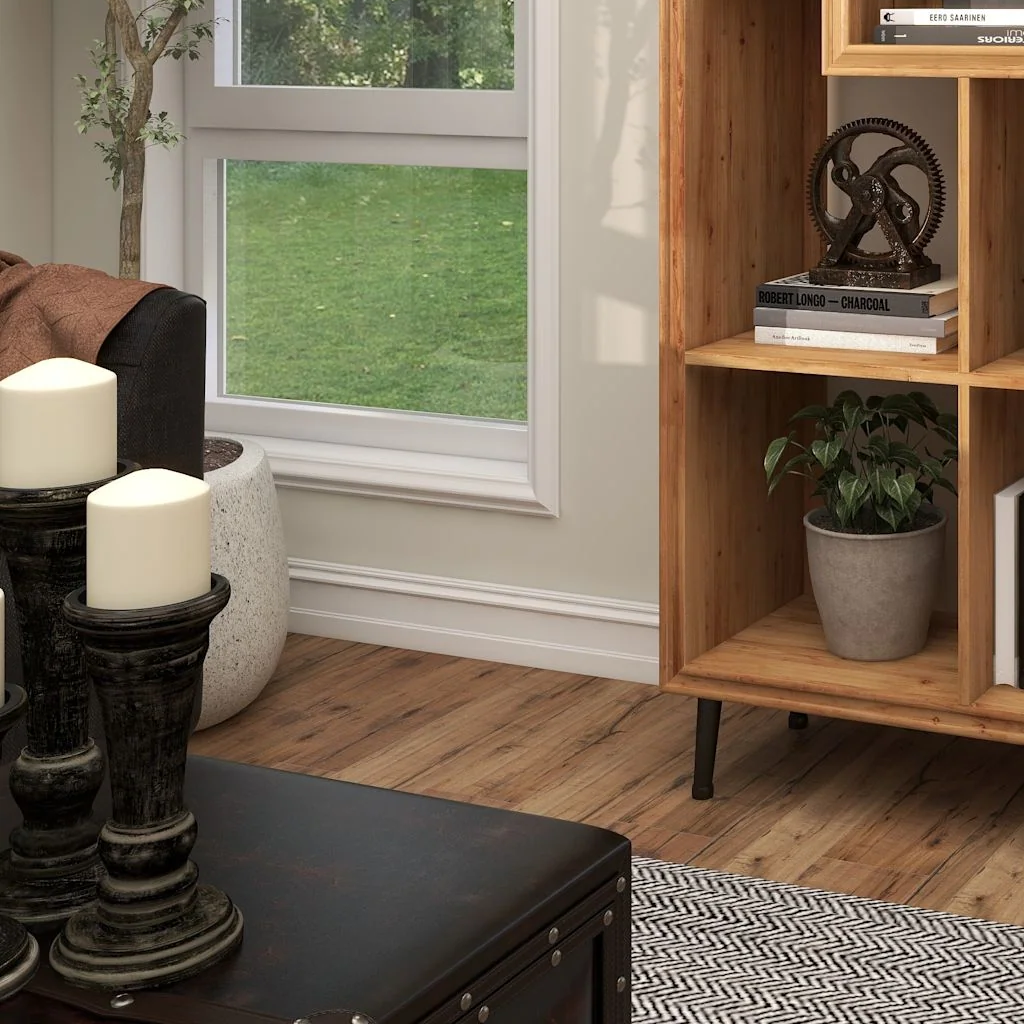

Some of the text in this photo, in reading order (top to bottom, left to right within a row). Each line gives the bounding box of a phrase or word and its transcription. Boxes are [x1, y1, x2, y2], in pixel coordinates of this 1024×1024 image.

[929, 13, 986, 22] EERO SAARINEN
[758, 290, 794, 305] ROBERT
[795, 292, 826, 307] LONGO
[841, 295, 891, 312] CHARCOAL
